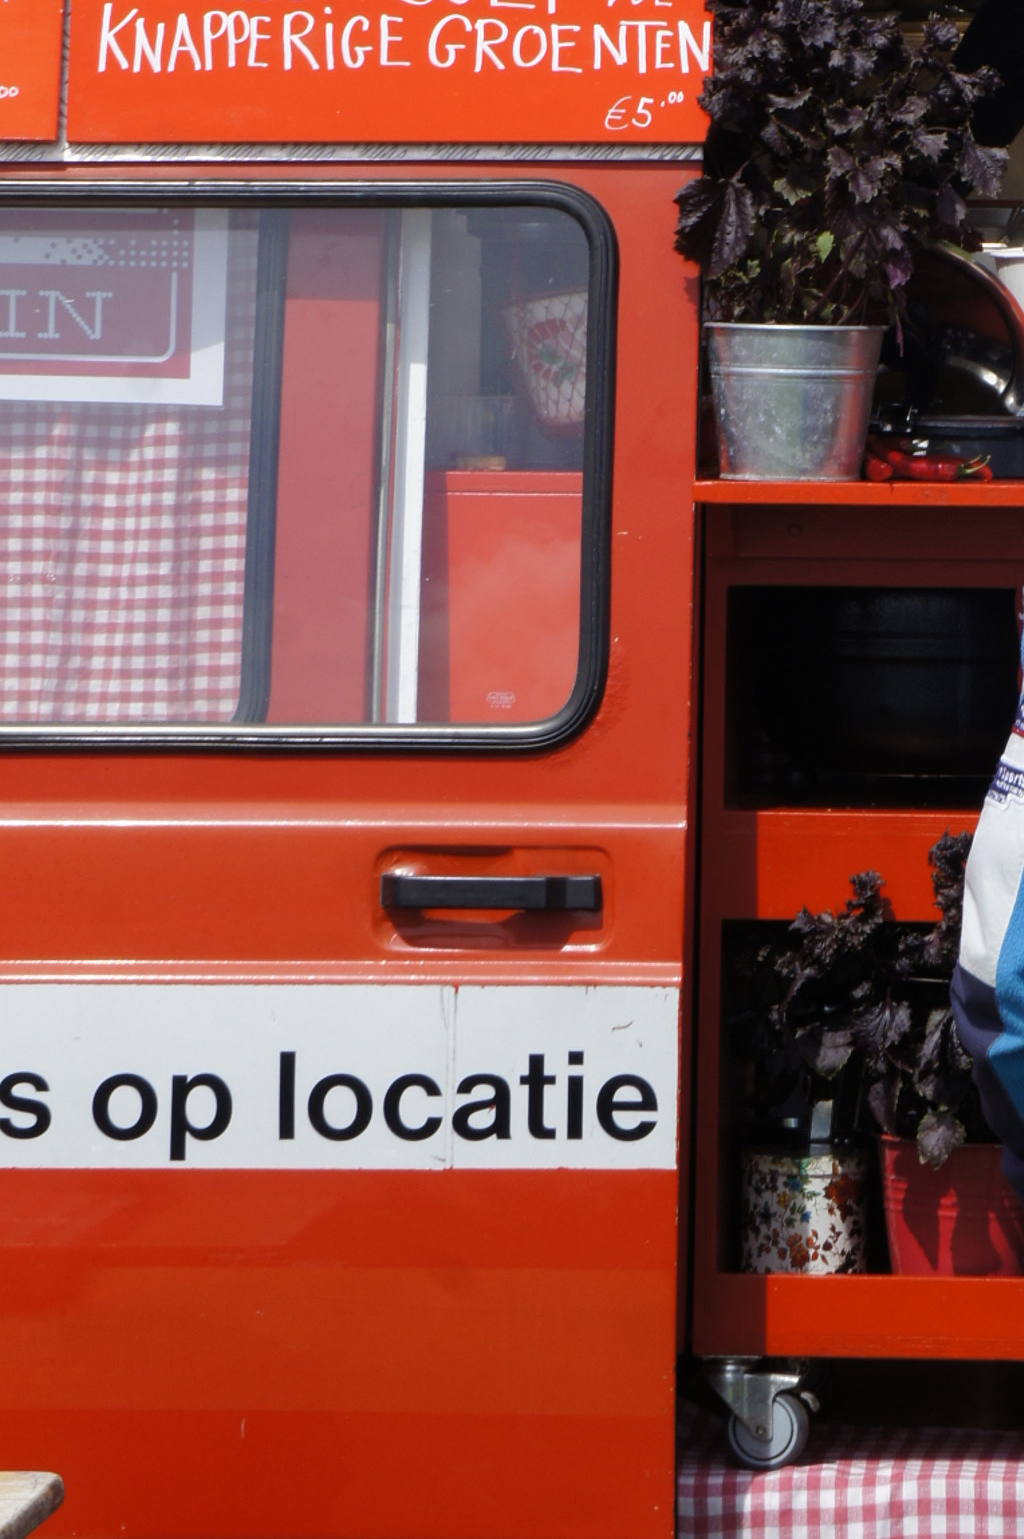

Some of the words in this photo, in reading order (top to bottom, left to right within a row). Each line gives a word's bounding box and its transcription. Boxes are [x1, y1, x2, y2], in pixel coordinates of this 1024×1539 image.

[428, 14, 711, 74] GROENTEN
[92, 1072, 233, 1161] op
[278, 1050, 658, 1141] locatie
